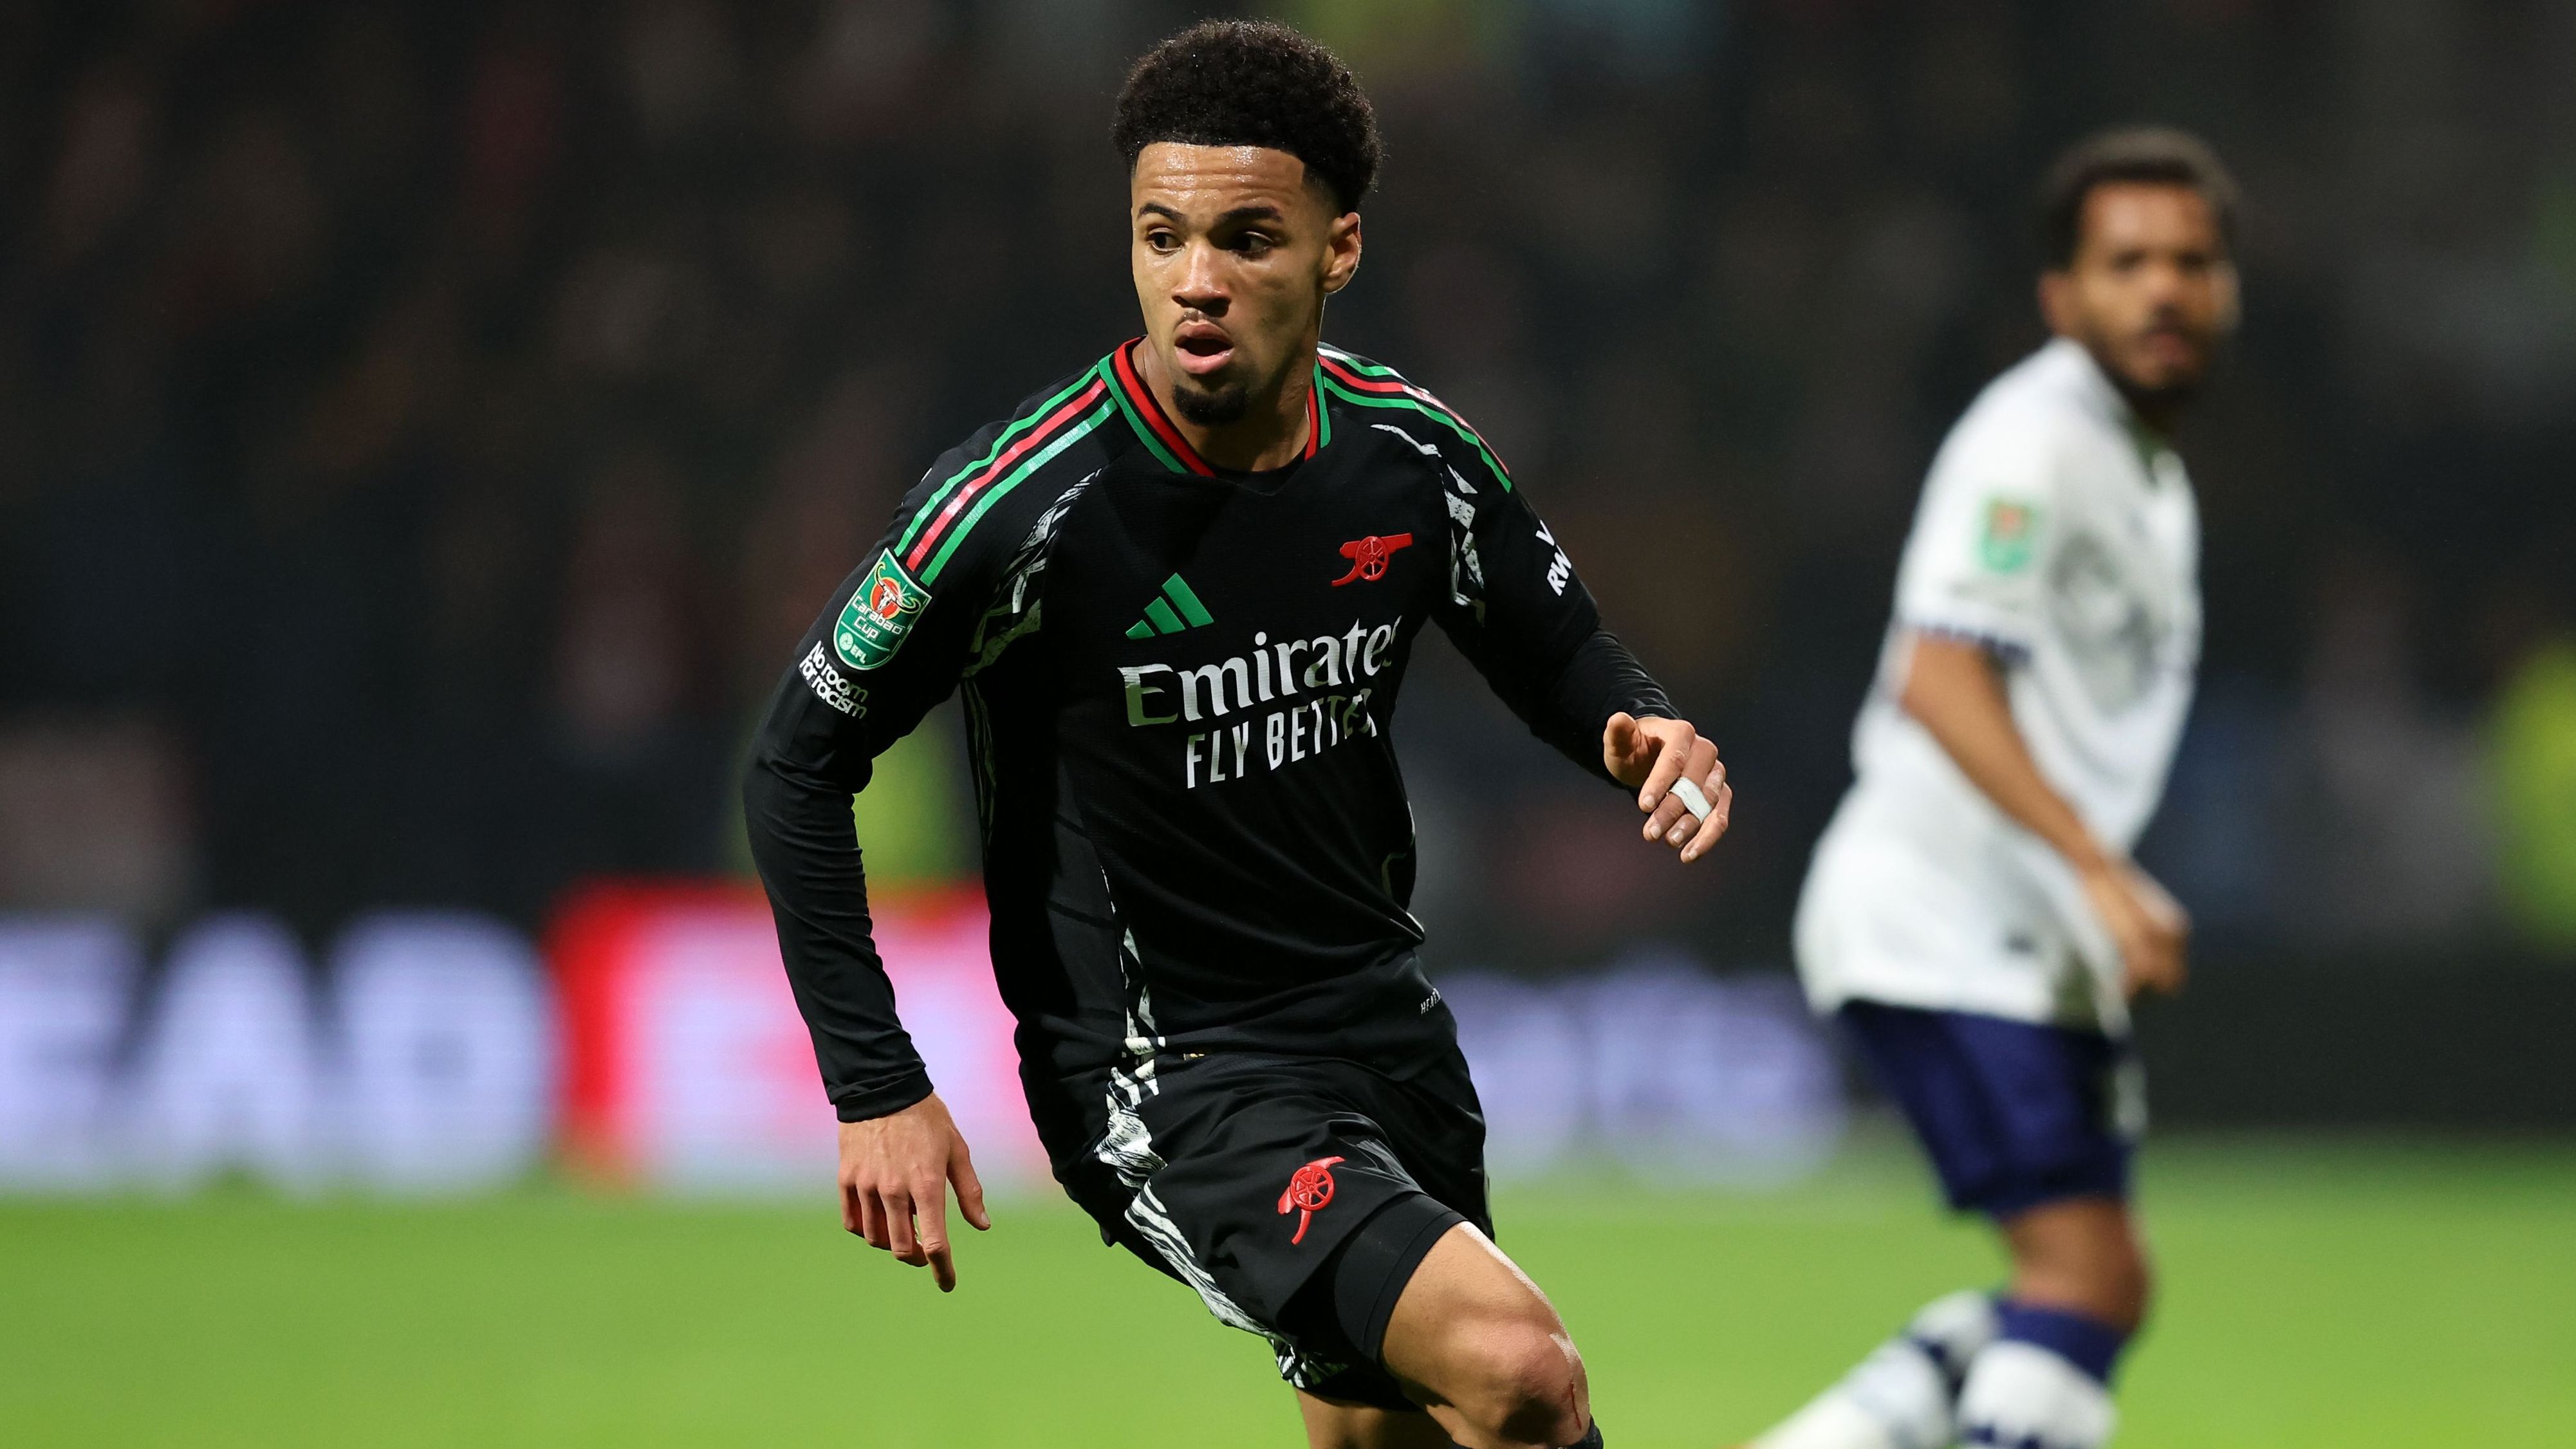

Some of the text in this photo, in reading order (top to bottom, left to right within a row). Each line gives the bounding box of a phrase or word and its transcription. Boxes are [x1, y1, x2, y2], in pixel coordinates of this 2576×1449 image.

[851, 595, 905, 635] Carabao
[853, 615, 880, 641] Cup
[809, 640, 869, 703] No room
[849, 645, 866, 664] EFL
[799, 654, 867, 719] for racism
[1187, 721, 1250, 789] FLY
